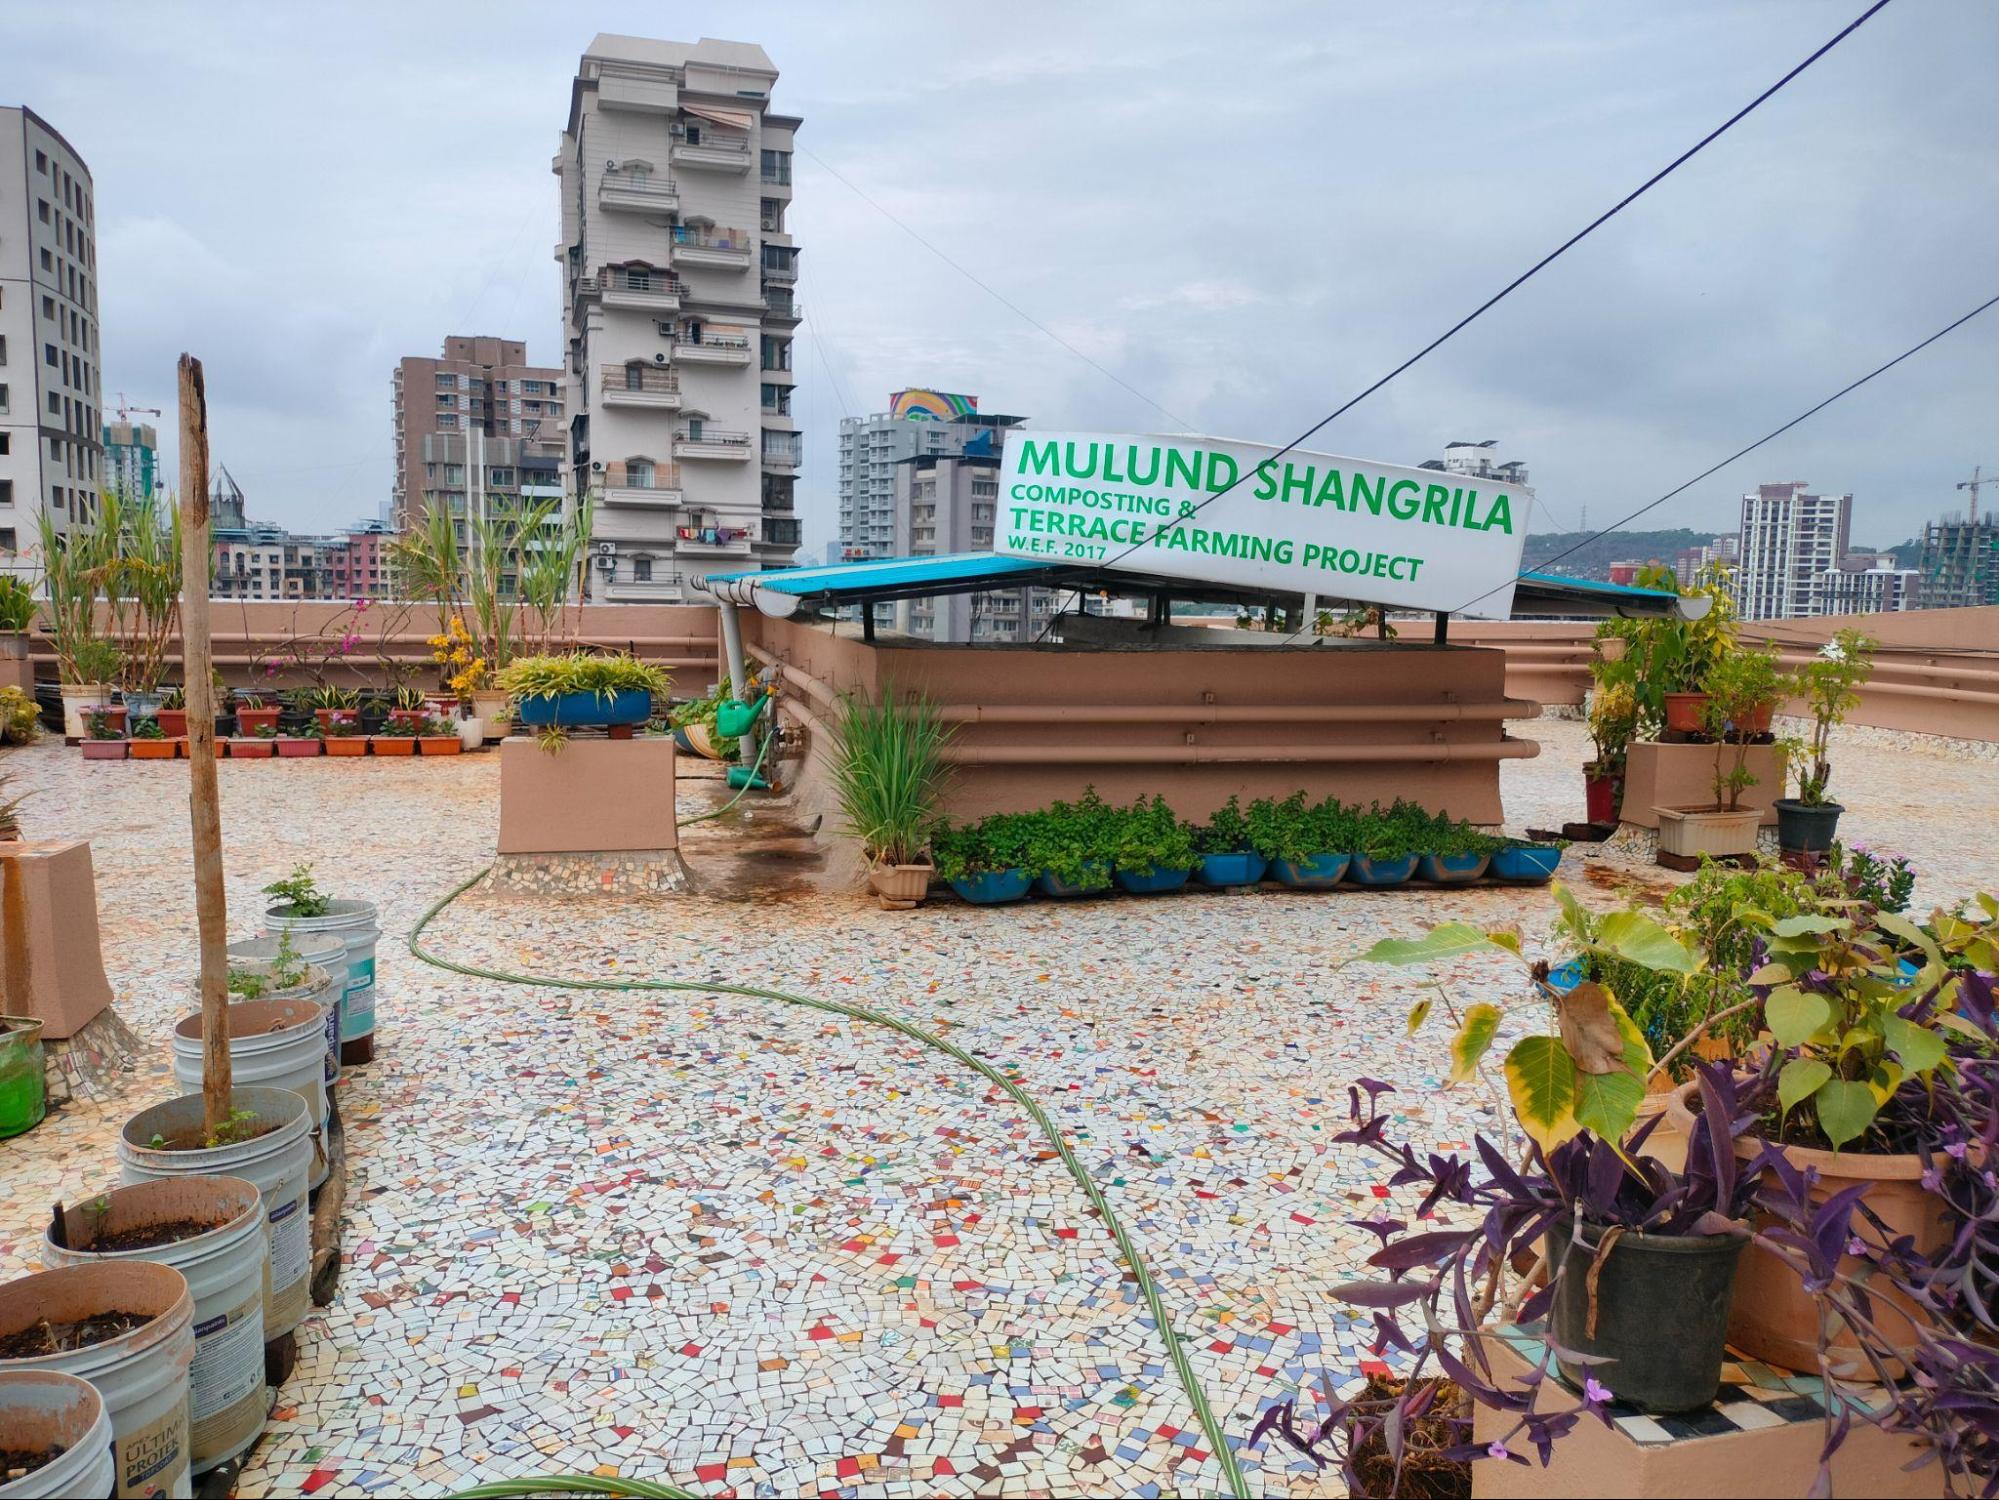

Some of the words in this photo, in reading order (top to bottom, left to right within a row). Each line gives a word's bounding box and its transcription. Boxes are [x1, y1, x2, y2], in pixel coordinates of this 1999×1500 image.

[1010, 484, 1170, 517] COMPOSTING
[1178, 500, 1197, 520] &
[1018, 440, 1239, 495] MULUND
[1253, 459, 1513, 535] SHANGRILA
[1008, 534, 1058, 555] W.E.F.
[1064, 541, 1107, 561] 2017
[1009, 507, 1147, 545] TERRACE
[1154, 523, 1294, 566] FARMING
[1301, 543, 1424, 581] PROJECT
